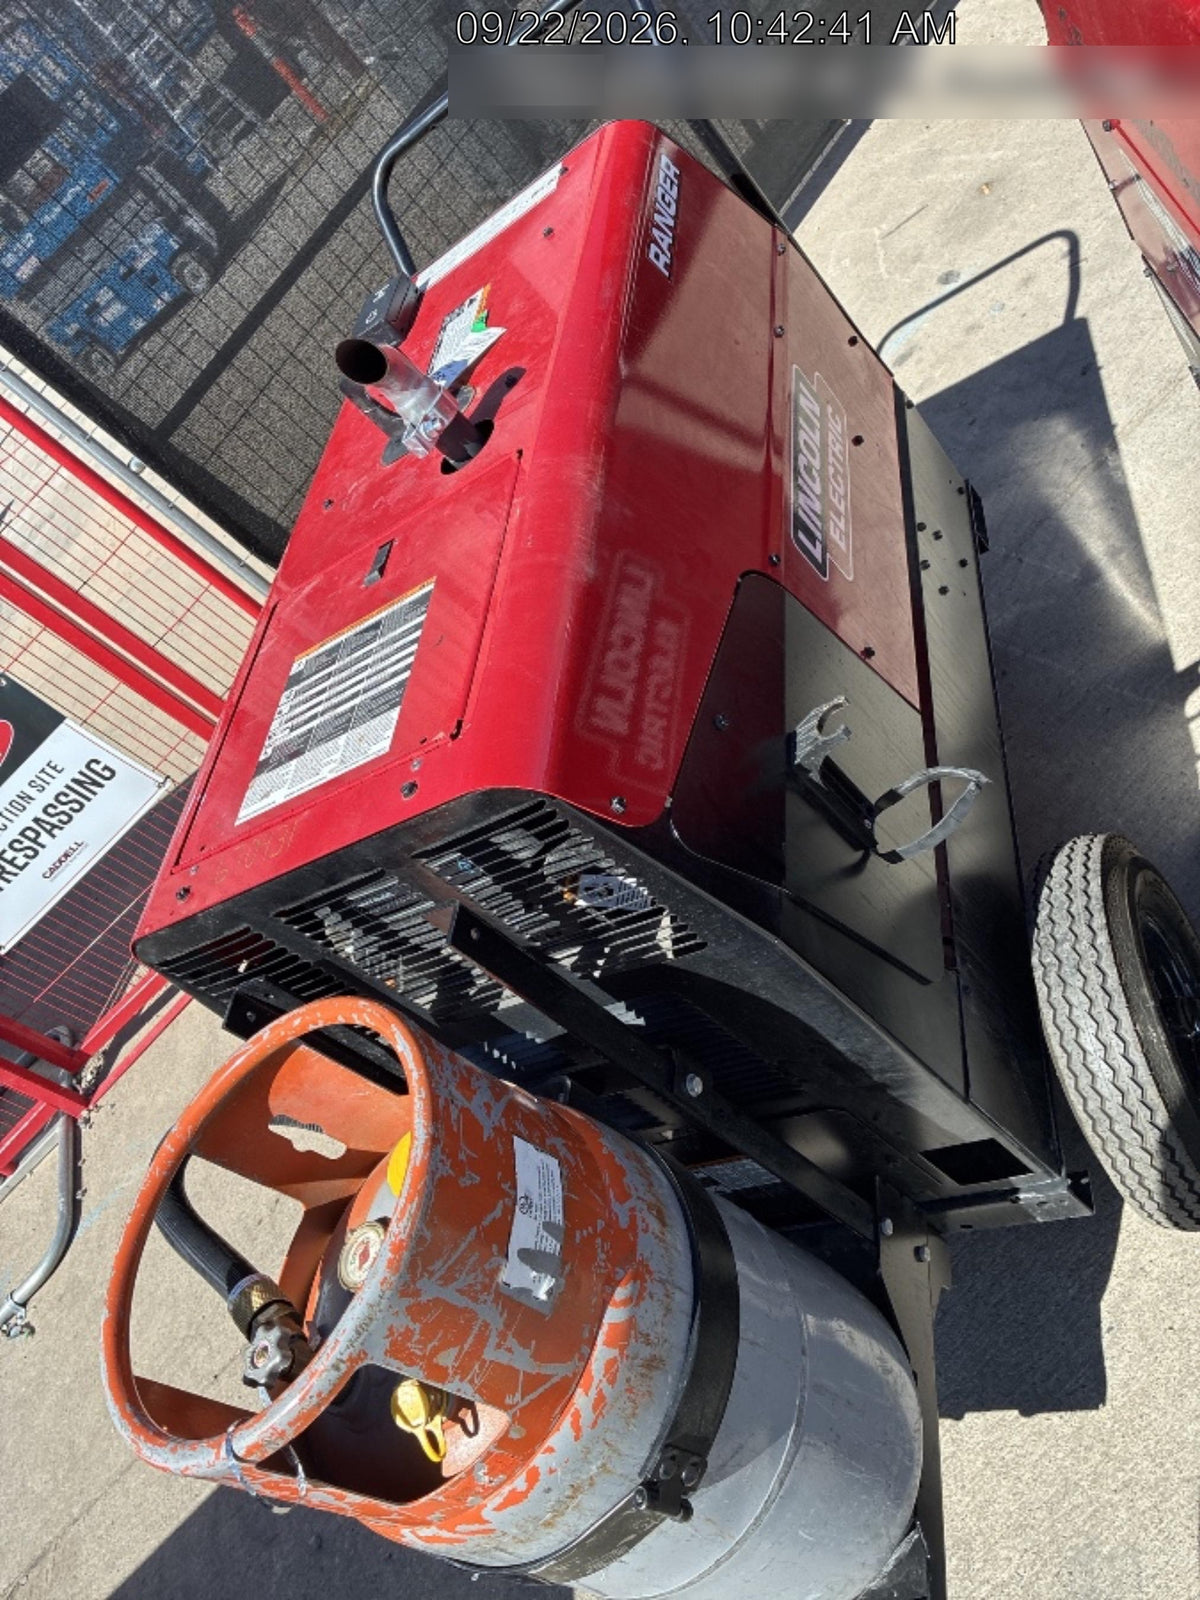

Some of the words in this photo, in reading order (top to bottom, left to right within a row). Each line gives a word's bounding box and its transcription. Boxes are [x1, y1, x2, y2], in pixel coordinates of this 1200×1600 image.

[648, 153, 680, 279] RANGER
[797, 380, 823, 564] LINCOLN
[827, 404, 847, 552] ELECTRIC
[0, 758, 116, 892] RESPASSING
[27, 760, 65, 793] SITE
